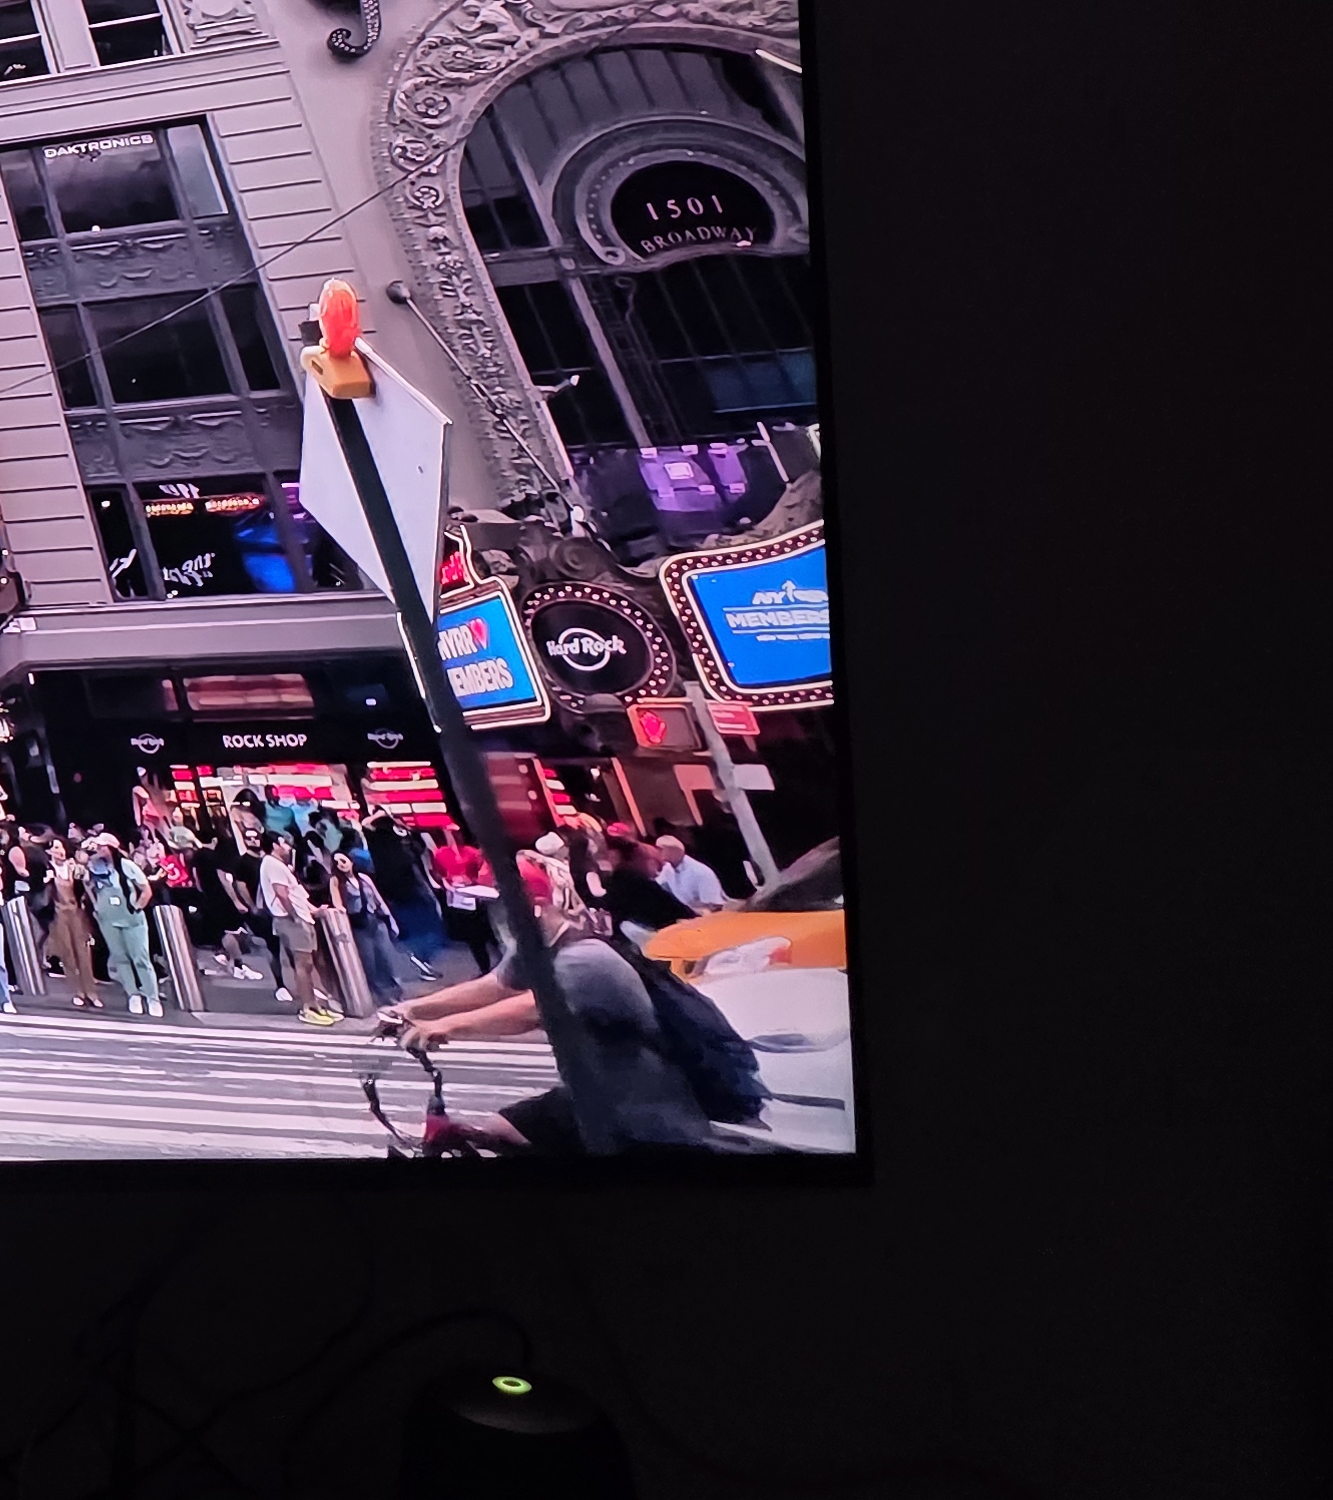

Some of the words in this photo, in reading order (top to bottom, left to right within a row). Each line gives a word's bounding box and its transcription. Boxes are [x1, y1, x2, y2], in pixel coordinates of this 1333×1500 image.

[44, 135, 153, 158] DAKTRONICS
[646, 195, 723, 220] 1501
[640, 226, 756, 253] BROADWAY
[726, 609, 830, 627] MEMBERS
[546, 638, 579, 656] Hard
[580, 635, 627, 656] Rock
[447, 658, 513, 697] EMBERS
[223, 734, 264, 749] ROCK
[267, 733, 308, 748] SHOP
